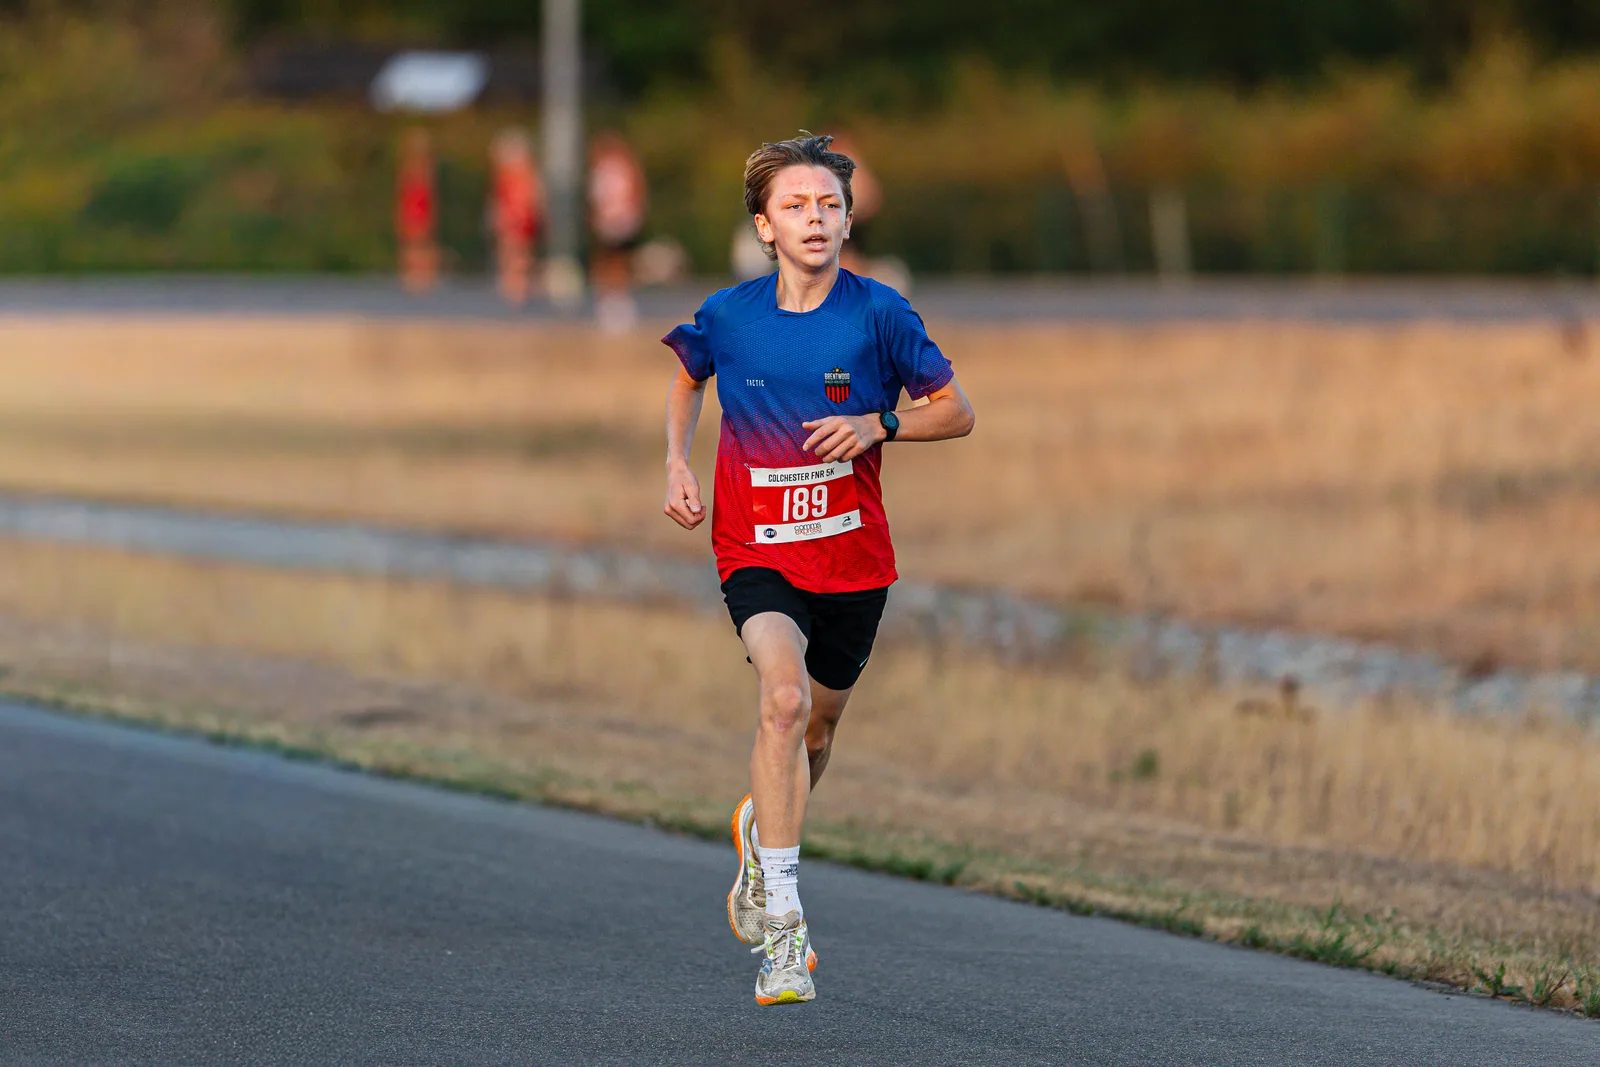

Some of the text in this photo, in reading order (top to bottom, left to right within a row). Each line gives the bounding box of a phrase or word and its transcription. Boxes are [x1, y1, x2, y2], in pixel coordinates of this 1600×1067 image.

[768, 467, 835, 482] COLCHESTER FNR 5K
[782, 484, 828, 522] 189
